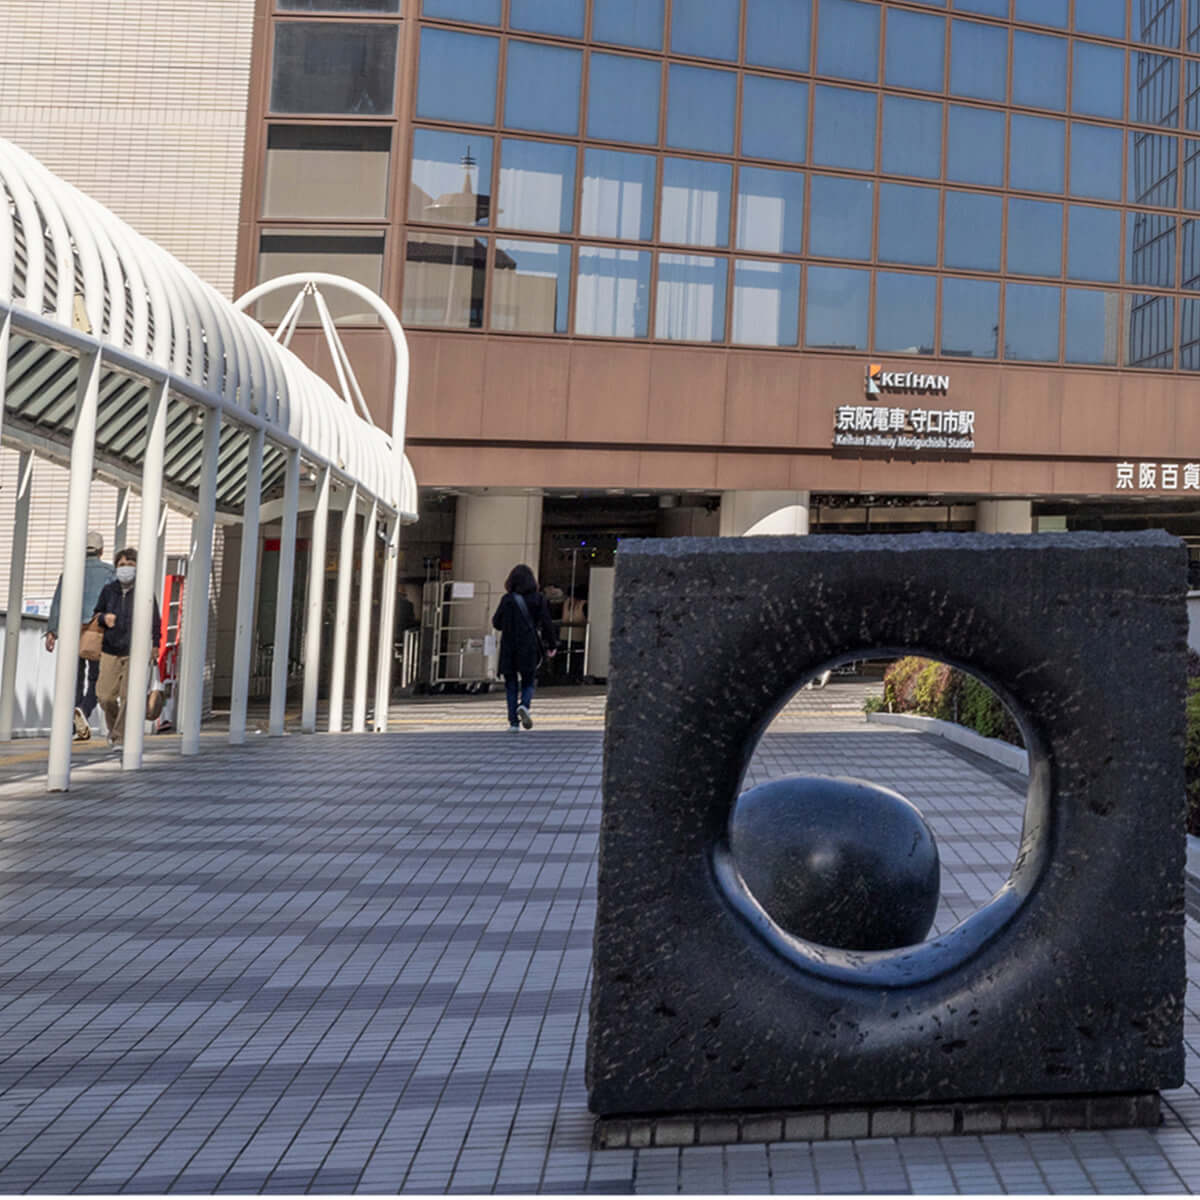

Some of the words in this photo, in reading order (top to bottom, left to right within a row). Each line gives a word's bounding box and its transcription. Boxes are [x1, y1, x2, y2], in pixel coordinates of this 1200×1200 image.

[881, 371, 950, 390] KEIHAN
[836, 405, 906, 432] 京阪電車
[909, 407, 976, 434] 守口市駅
[835, 433, 865, 446] Keihan
[866, 434, 897, 449] Railway
[948, 437, 976, 449] Station
